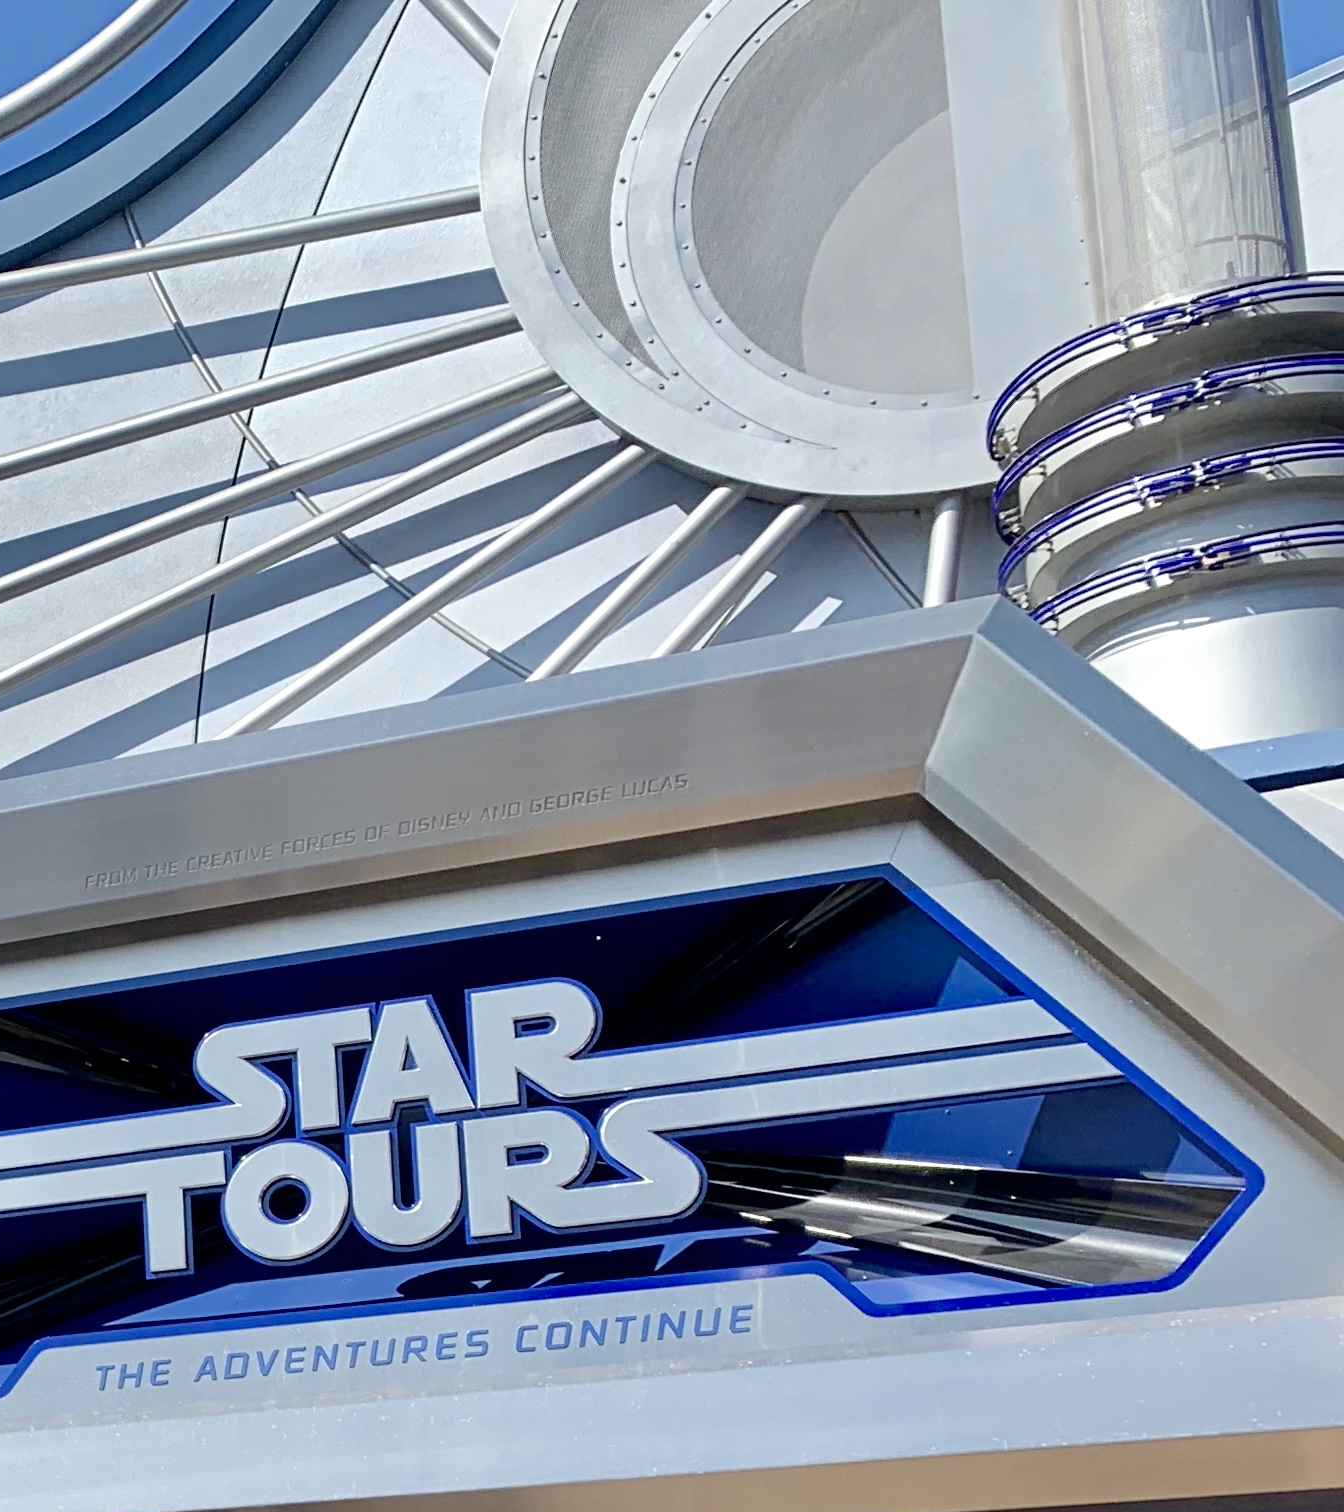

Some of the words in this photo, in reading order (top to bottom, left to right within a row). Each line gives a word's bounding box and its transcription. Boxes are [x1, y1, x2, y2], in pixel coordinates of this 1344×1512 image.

[84, 868, 137, 891] FROM
[143, 860, 180, 882] THE
[186, 844, 274, 874] CREATIVE
[280, 830, 356, 857] FORCES
[363, 822, 391, 843] OF
[397, 809, 472, 838] DISNEY
[480, 801, 521, 824] AND
[529, 786, 613, 814] GEORGE
[621, 772, 689, 799] LUCAS
[195, 977, 602, 1139] STAR
[112, 1109, 705, 1280] TOURS
[96, 1359, 171, 1392] THE
[194, 1328, 490, 1382] ADVENTURES
[515, 1304, 754, 1355] CONTINUE
